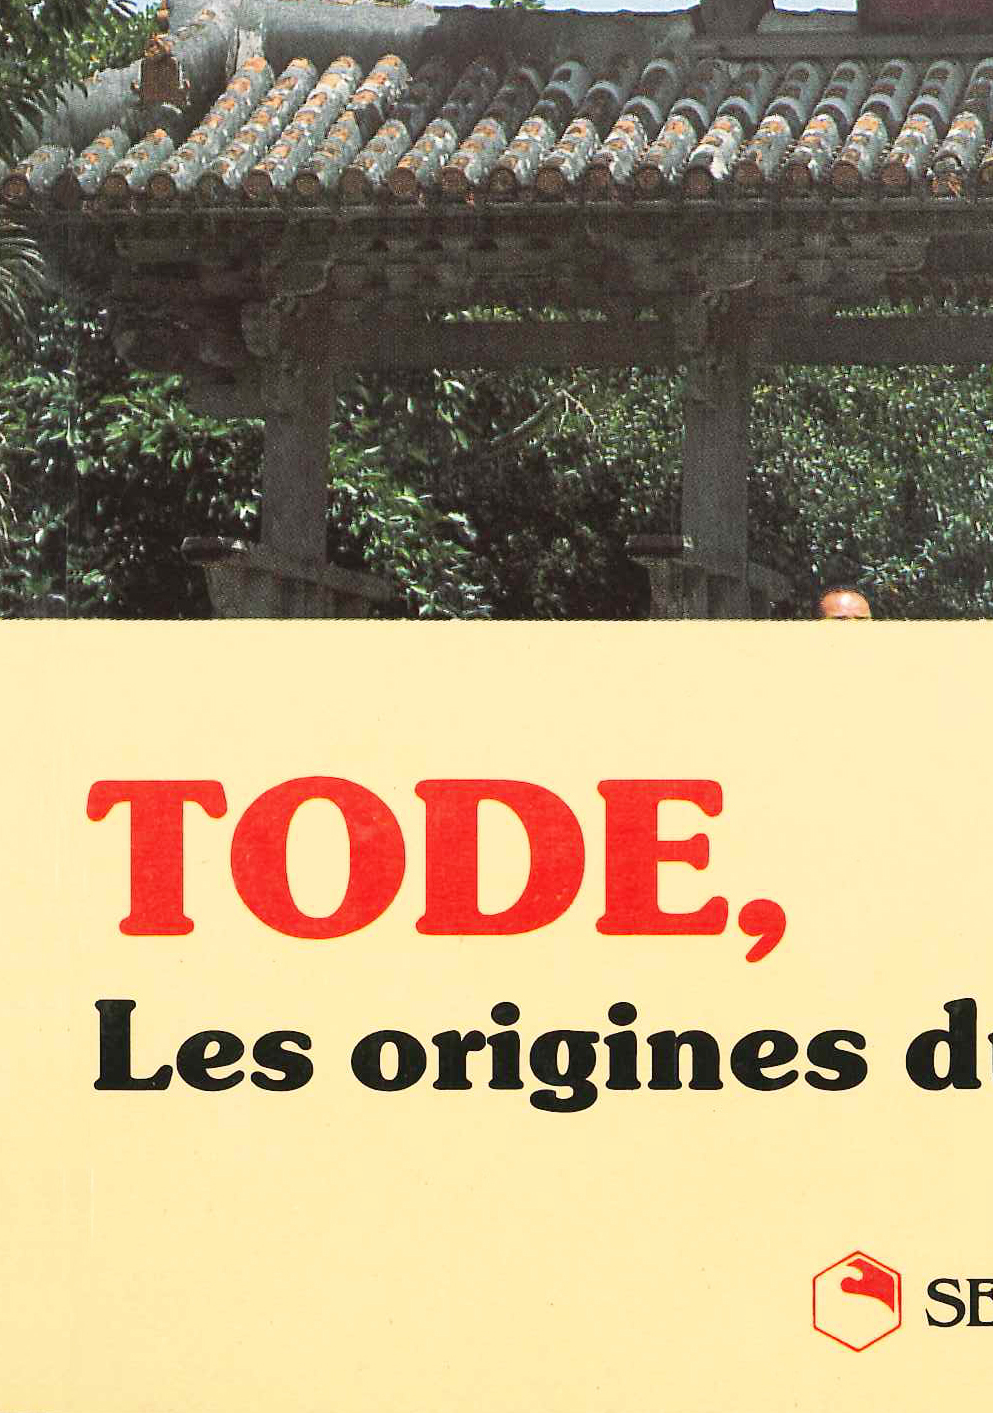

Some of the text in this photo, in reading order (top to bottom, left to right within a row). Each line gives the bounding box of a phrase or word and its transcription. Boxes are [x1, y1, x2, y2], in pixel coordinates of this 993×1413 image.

[87, 776, 786, 962] TODE,
[94, 1000, 313, 1091] Les
[351, 1002, 867, 1113] origines
